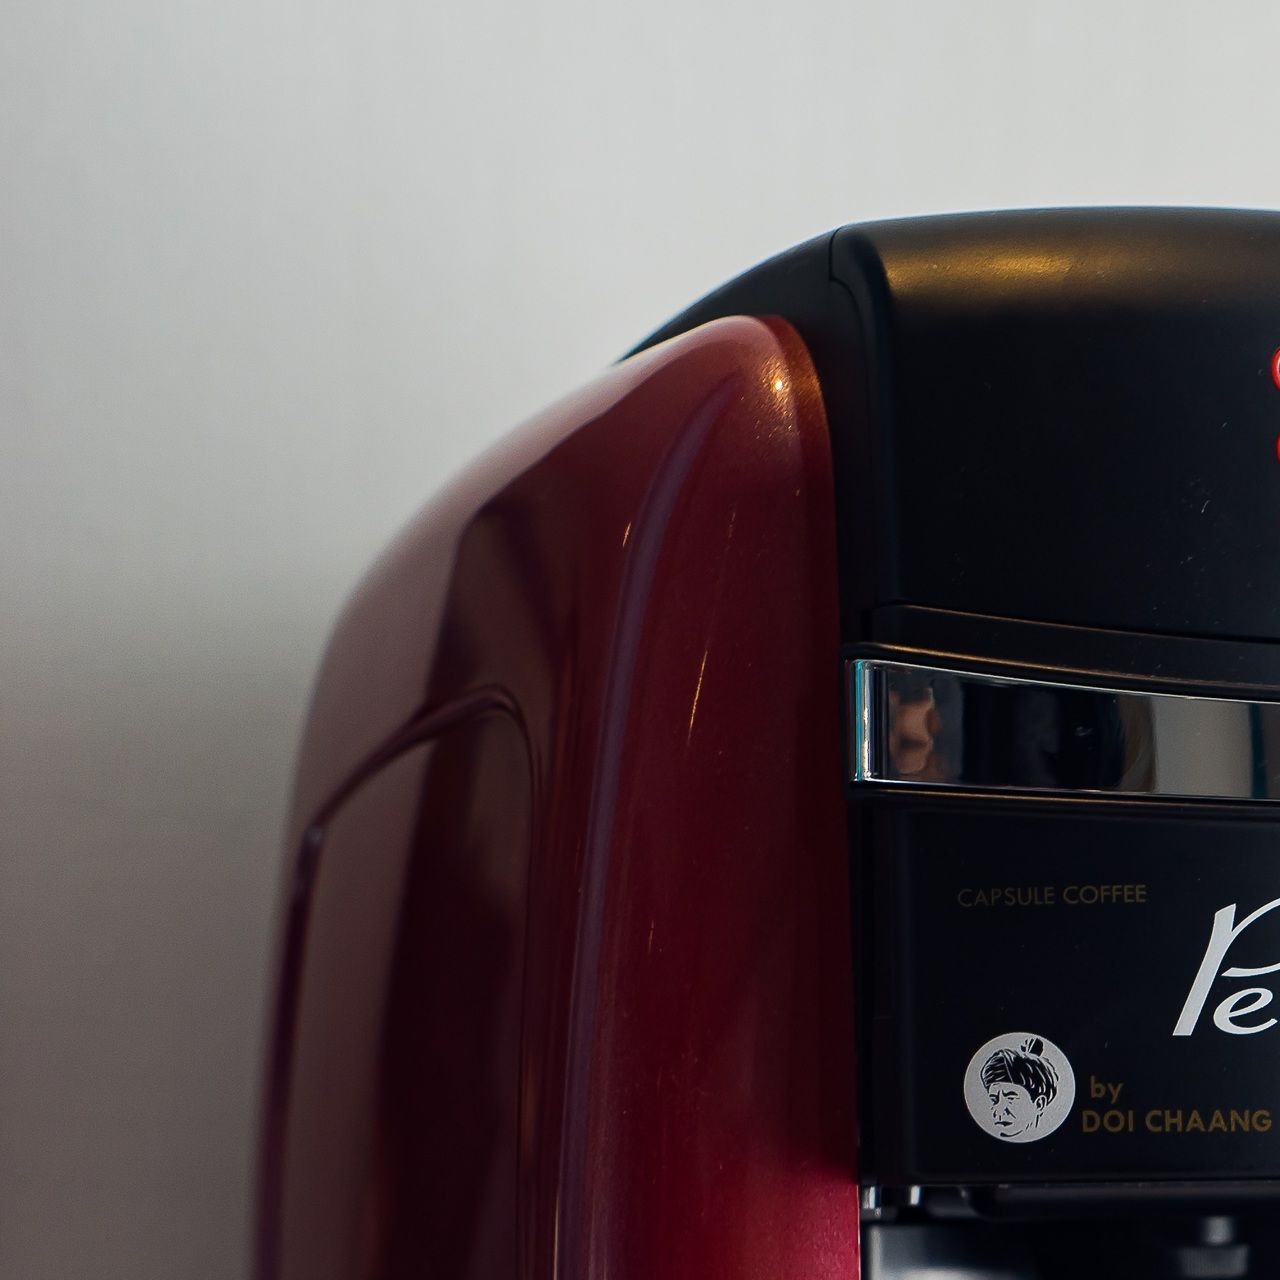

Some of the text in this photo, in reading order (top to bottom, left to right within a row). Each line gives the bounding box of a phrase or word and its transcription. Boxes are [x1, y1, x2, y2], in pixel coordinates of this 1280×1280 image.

[957, 884, 1147, 908] CAPSULE COFFEE
[1090, 1075, 1124, 1103] by
[1081, 1111, 1135, 1134] DOI
[1145, 1109, 1273, 1134] CHAANG
